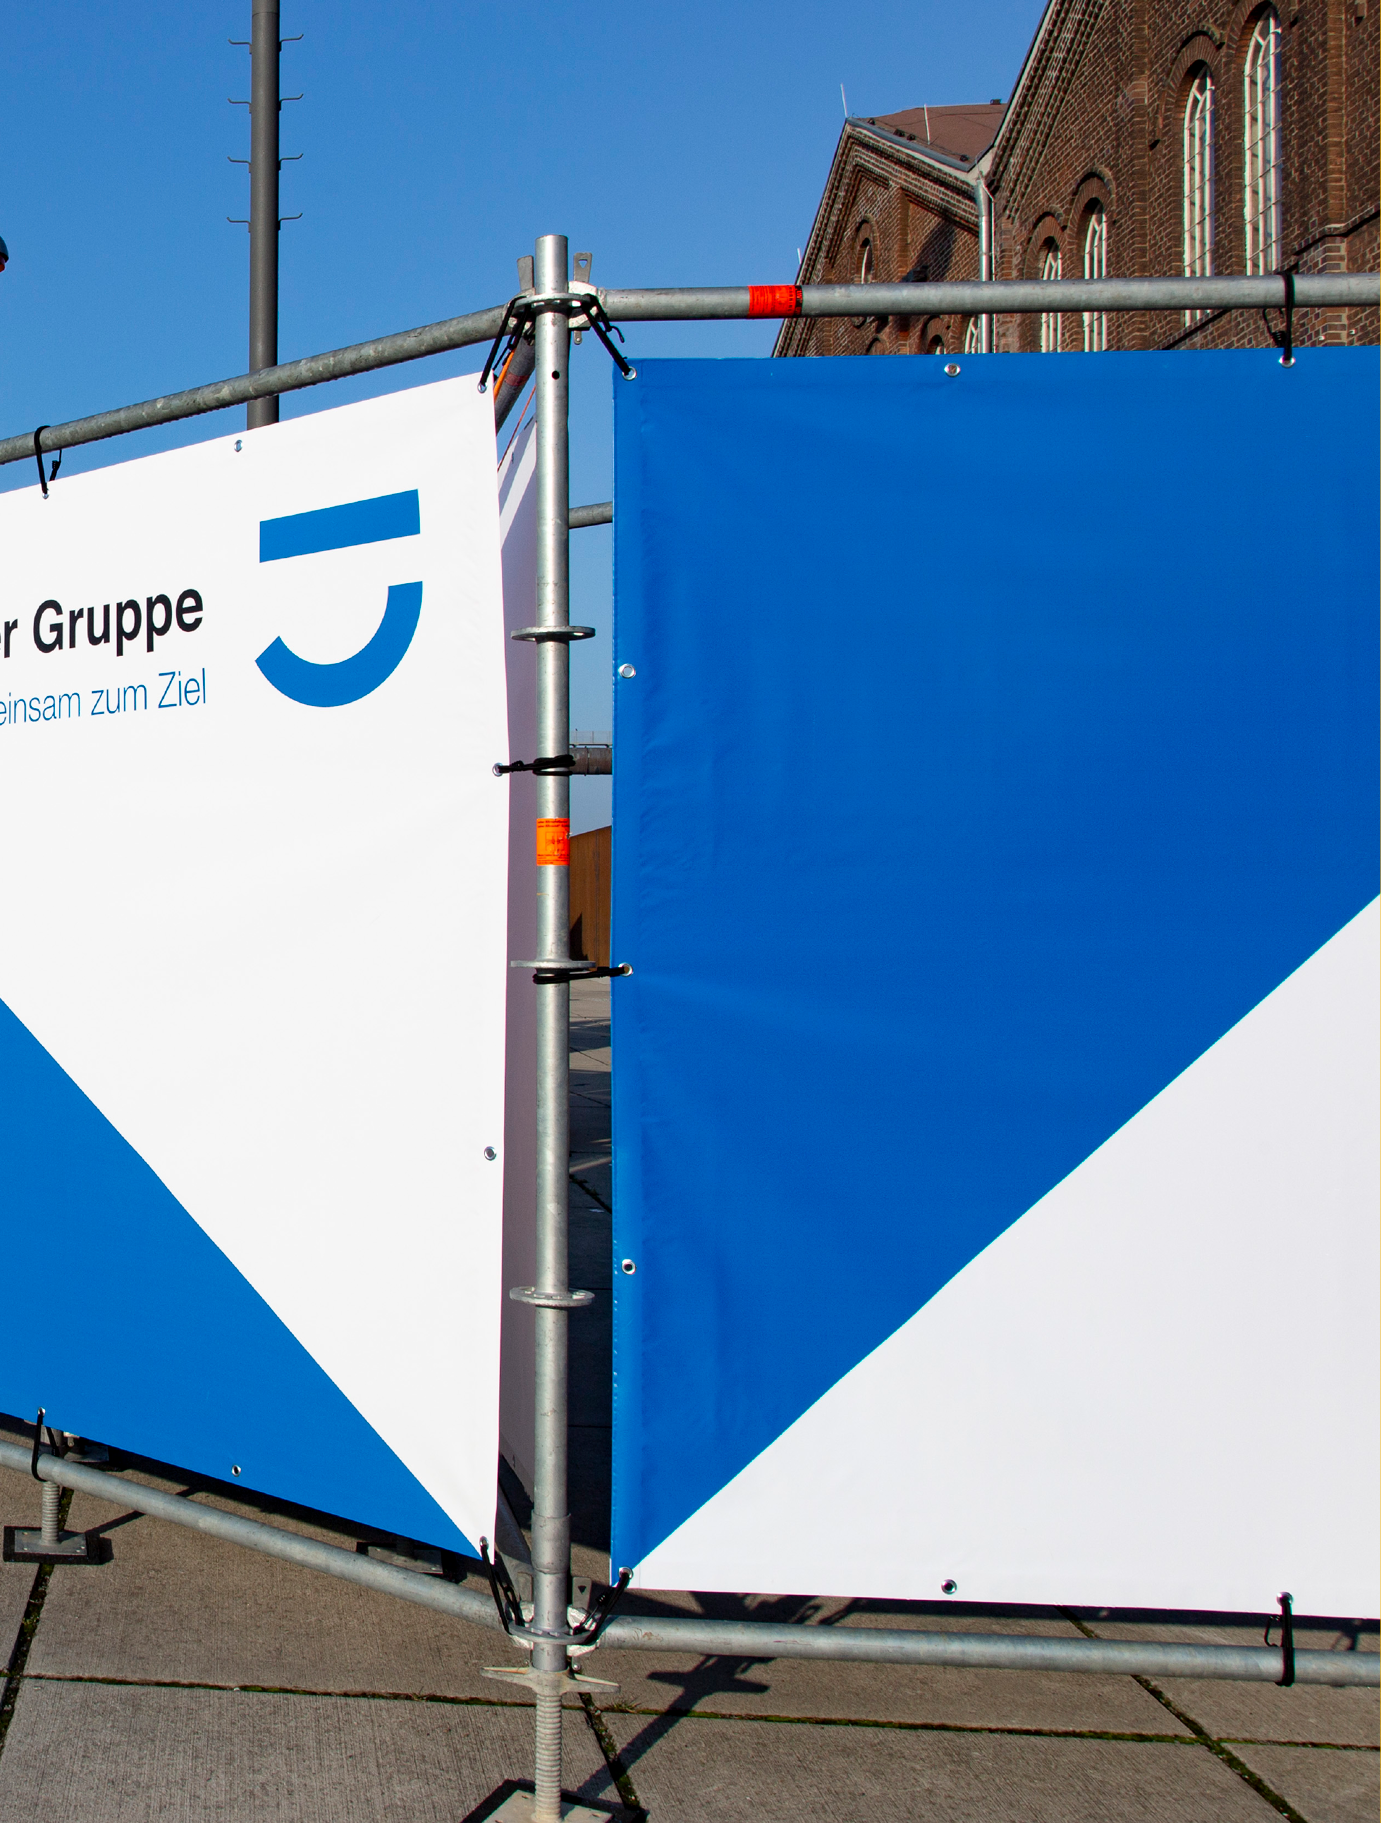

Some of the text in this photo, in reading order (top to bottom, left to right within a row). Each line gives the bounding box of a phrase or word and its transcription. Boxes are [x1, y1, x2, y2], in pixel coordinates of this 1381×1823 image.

[32, 588, 205, 658] Gruppe
[90, 683, 148, 716] zum
[157, 667, 208, 709] Ziel
